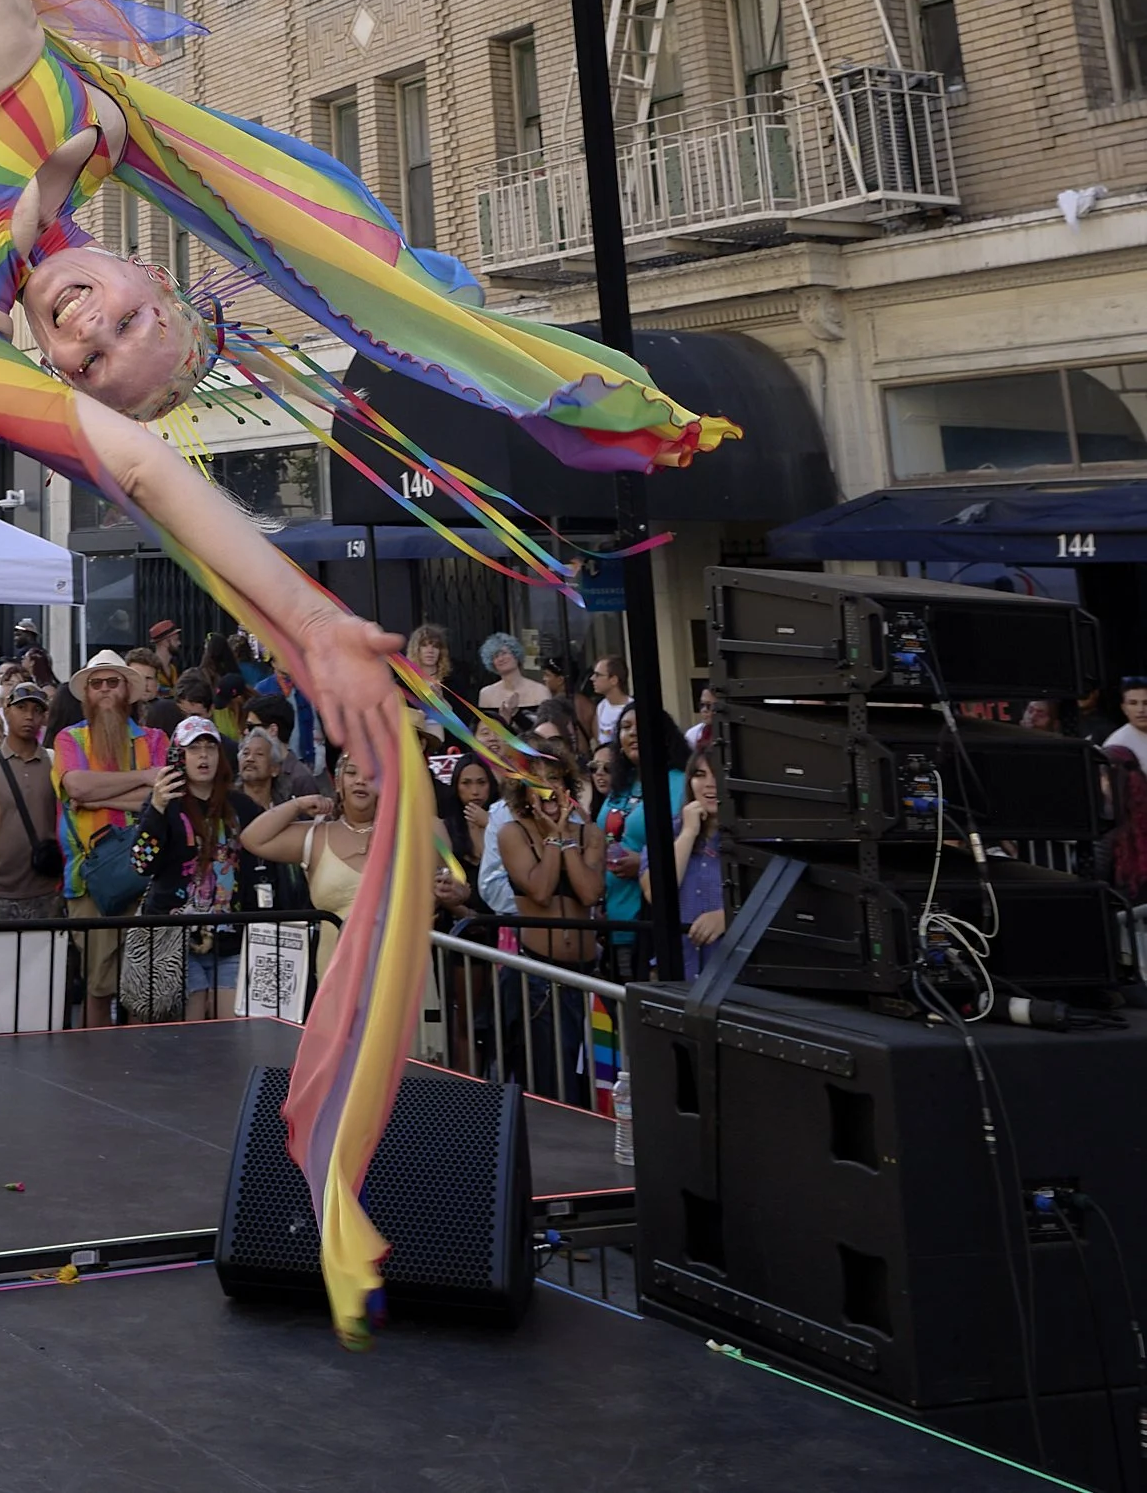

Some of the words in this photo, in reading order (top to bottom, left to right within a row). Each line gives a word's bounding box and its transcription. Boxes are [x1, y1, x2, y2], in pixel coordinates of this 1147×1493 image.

[399, 470, 434, 499] 146
[346, 539, 366, 558] 150
[1056, 533, 1096, 558] 144
